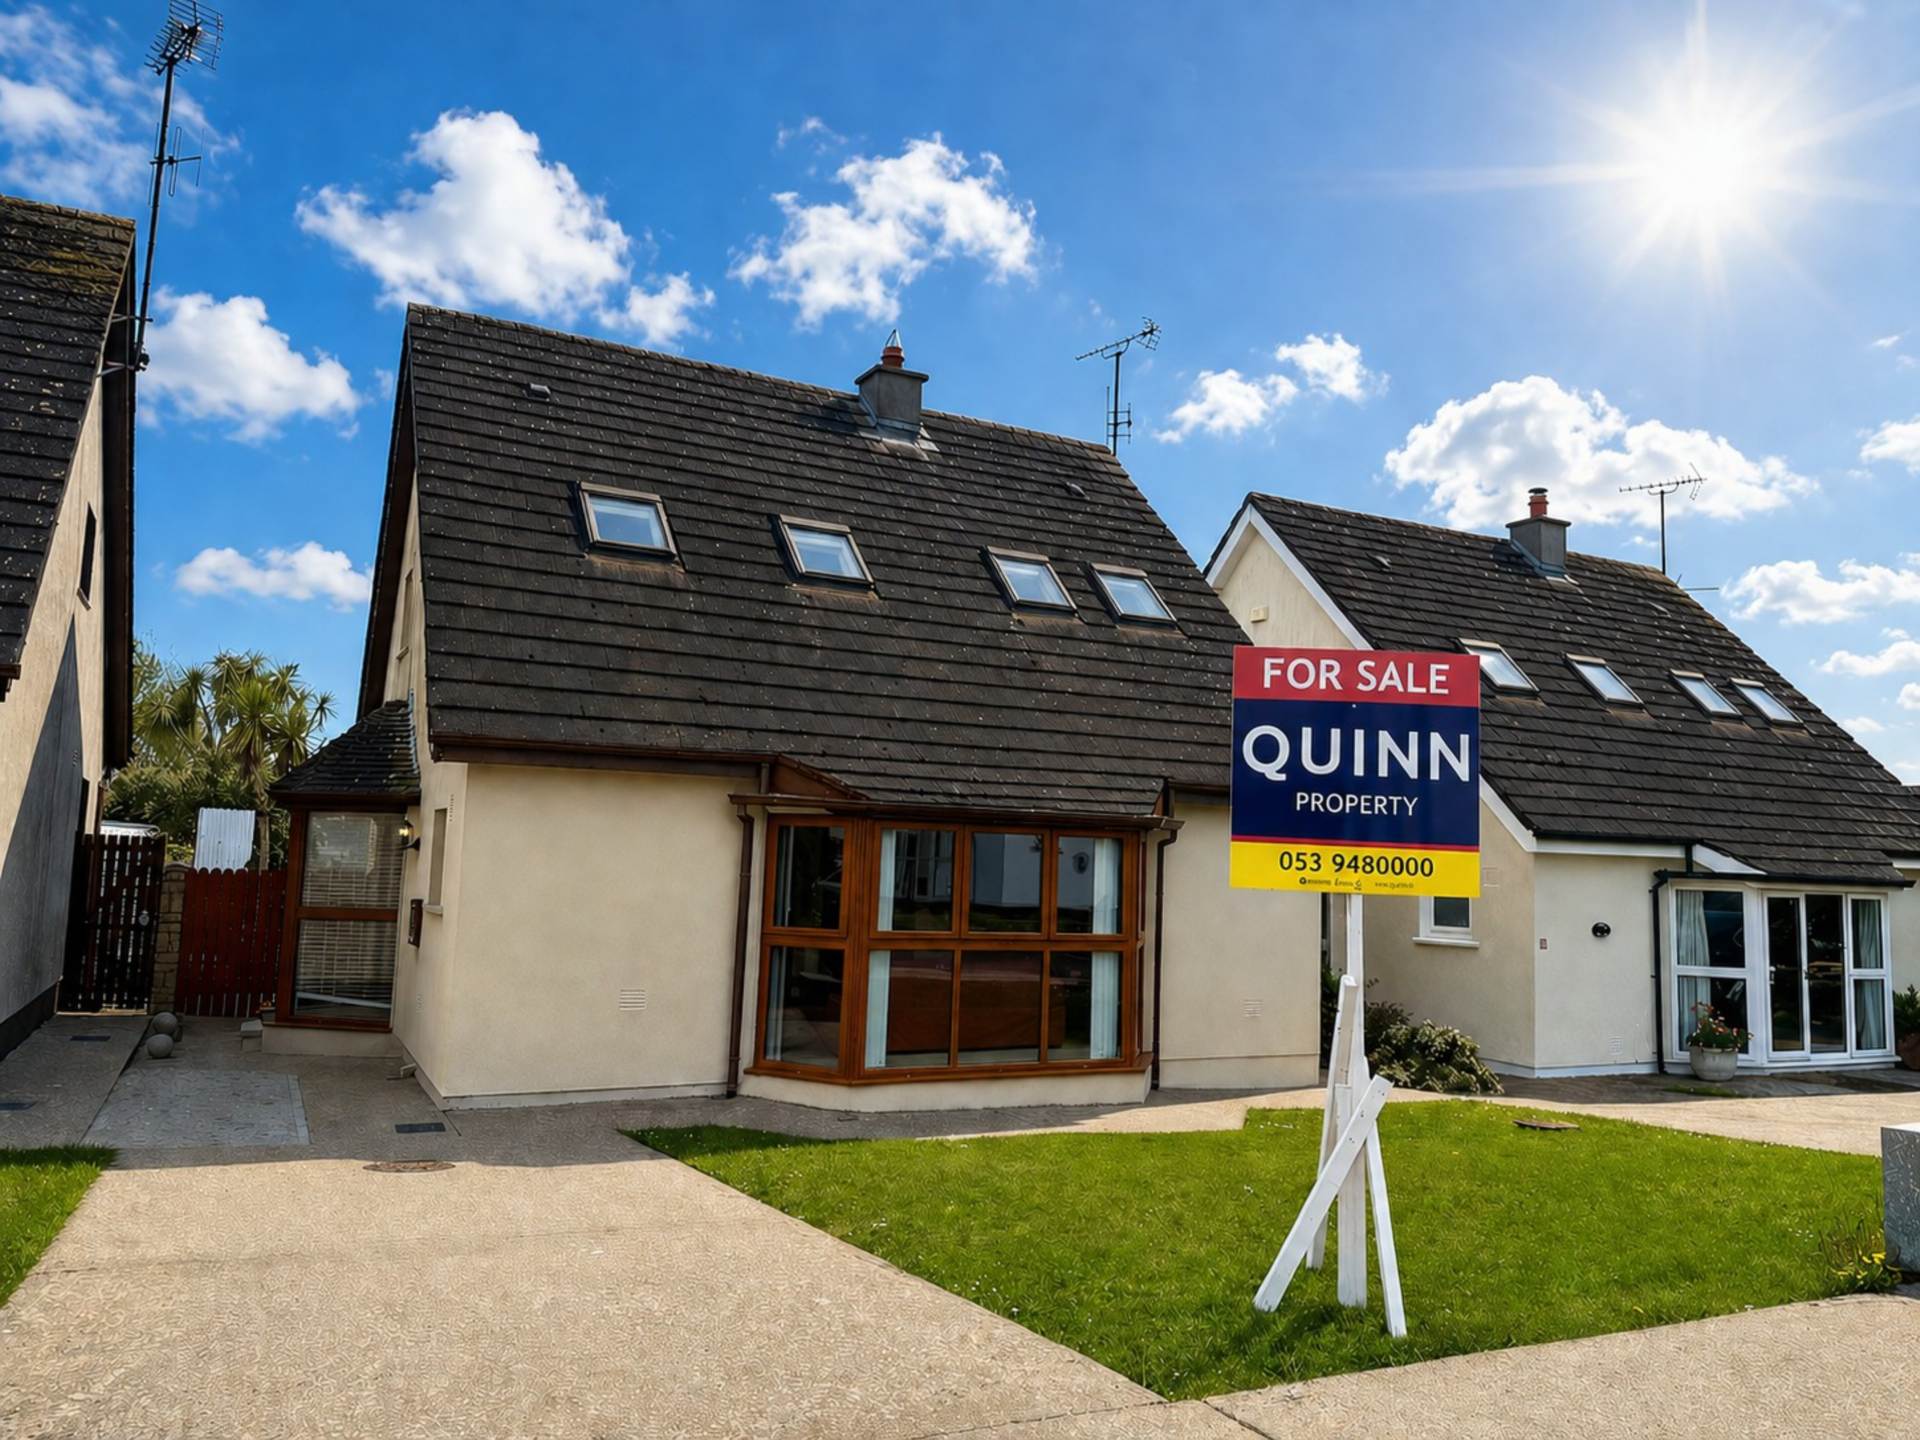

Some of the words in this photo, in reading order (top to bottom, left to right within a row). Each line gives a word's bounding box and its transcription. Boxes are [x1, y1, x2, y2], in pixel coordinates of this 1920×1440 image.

[1263, 658, 1343, 690] FOR
[1357, 661, 1450, 694] SALE
[1242, 724, 1470, 783] QUINN
[1296, 792, 1418, 816] PROPERTY
[1279, 851, 1322, 872] 053
[1332, 853, 1434, 877] 9480000
